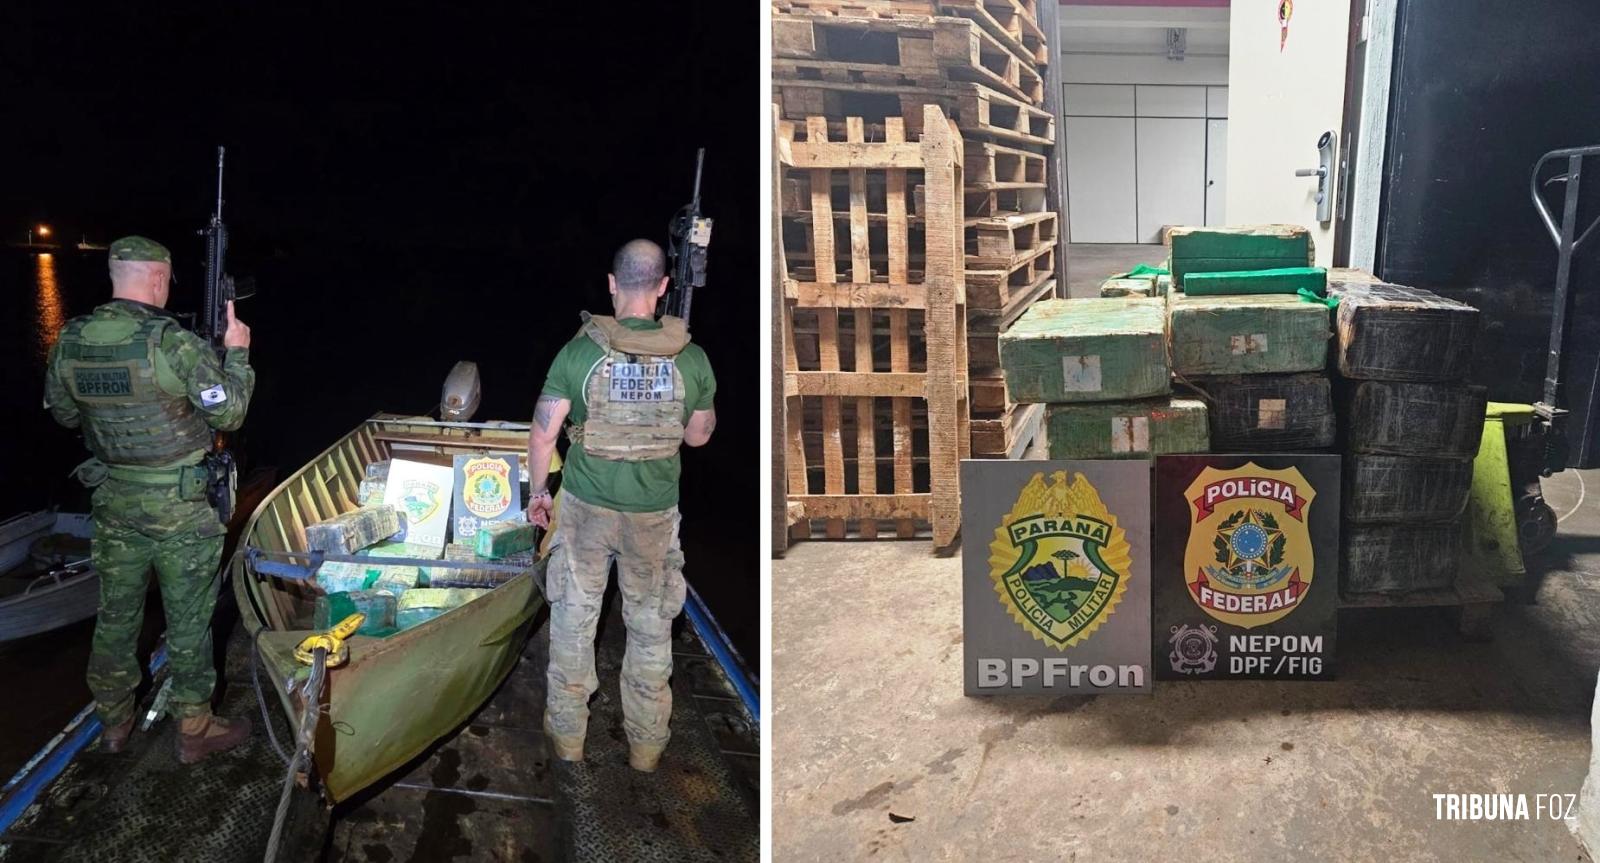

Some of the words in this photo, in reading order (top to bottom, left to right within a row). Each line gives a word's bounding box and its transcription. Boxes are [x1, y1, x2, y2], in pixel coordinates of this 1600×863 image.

[78, 381, 130, 394] BPFRON
[621, 391, 662, 400] NEPOM
[1013, 519, 1107, 541] PARANÁ
[1067, 577, 1112, 631] MILITAR
[1200, 586, 1296, 613] FEDERAL
[1229, 635, 1323, 653] NEPOM
[977, 657, 1144, 688] BPFron
[1229, 655, 1323, 675] DPF/FIG
